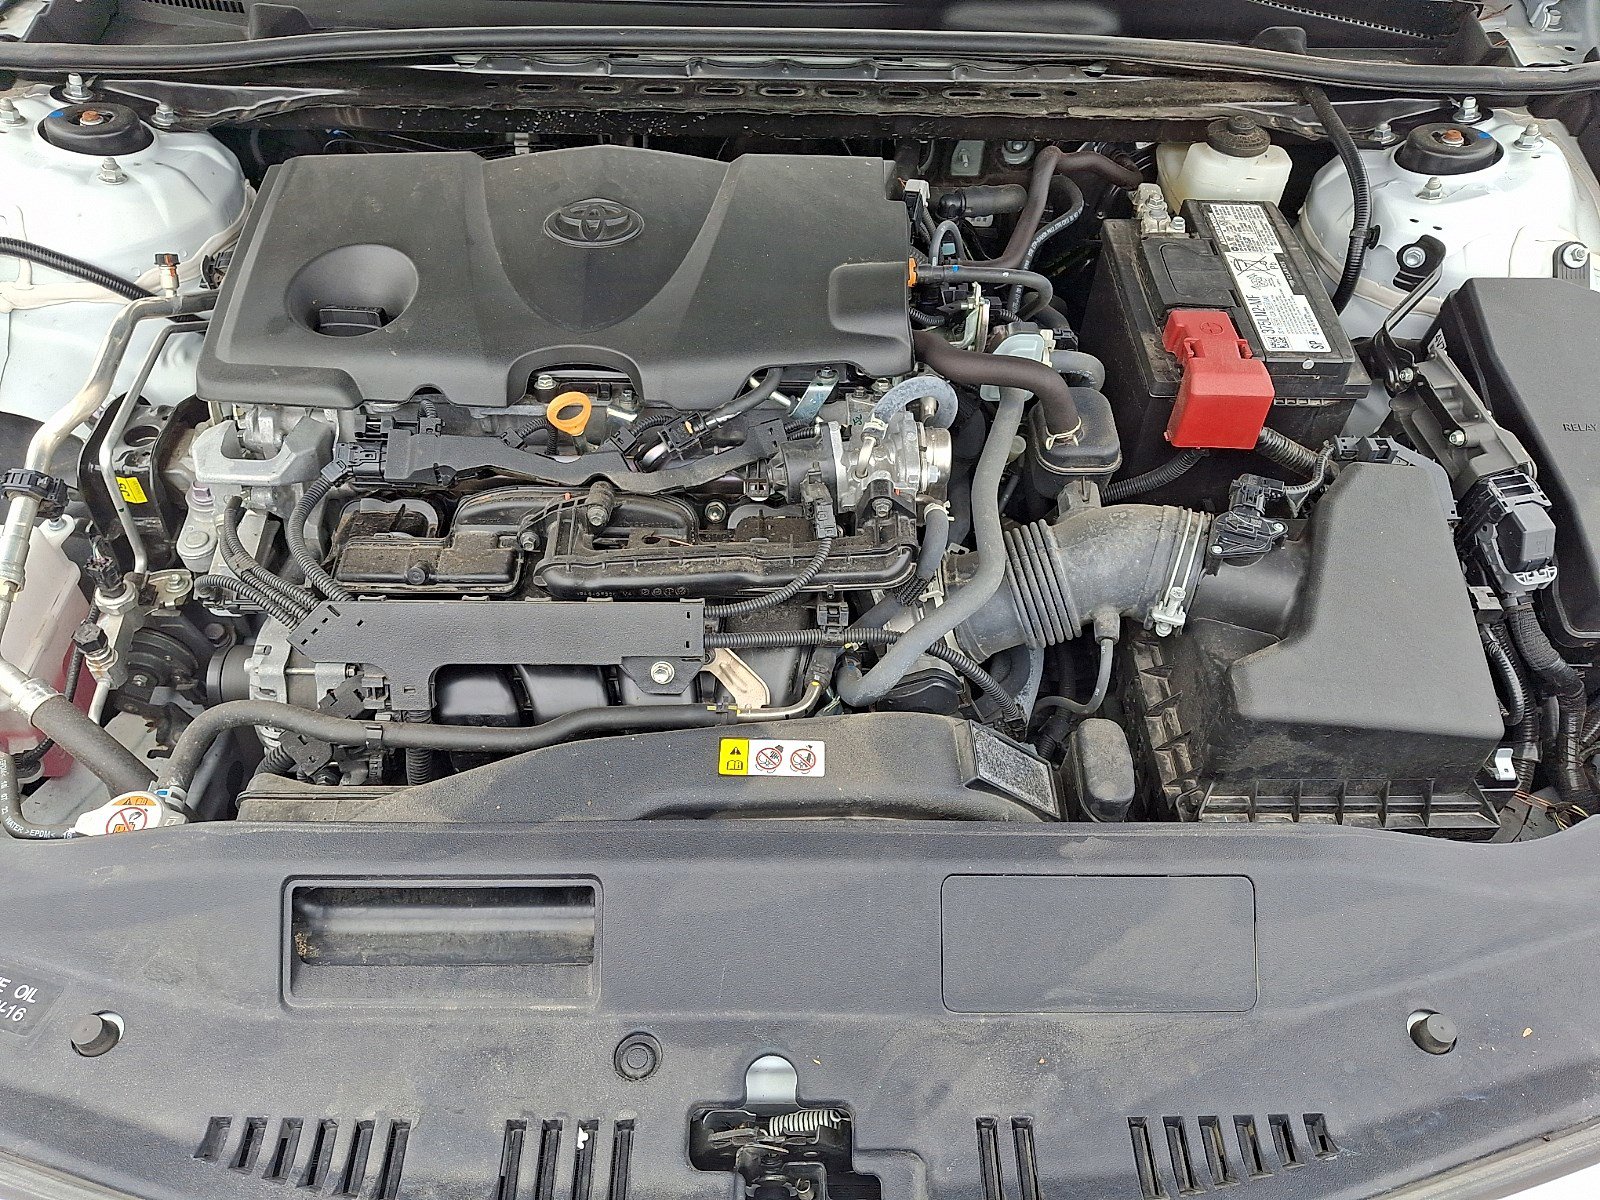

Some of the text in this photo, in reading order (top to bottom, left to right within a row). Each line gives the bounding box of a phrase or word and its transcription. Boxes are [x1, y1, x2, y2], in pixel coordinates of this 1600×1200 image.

[1309, 341, 1325, 350] SP
[1562, 423, 1597, 432] RELAY
[5, 815, 24, 834] WATER
[14, 984, 39, 1004] OIL
